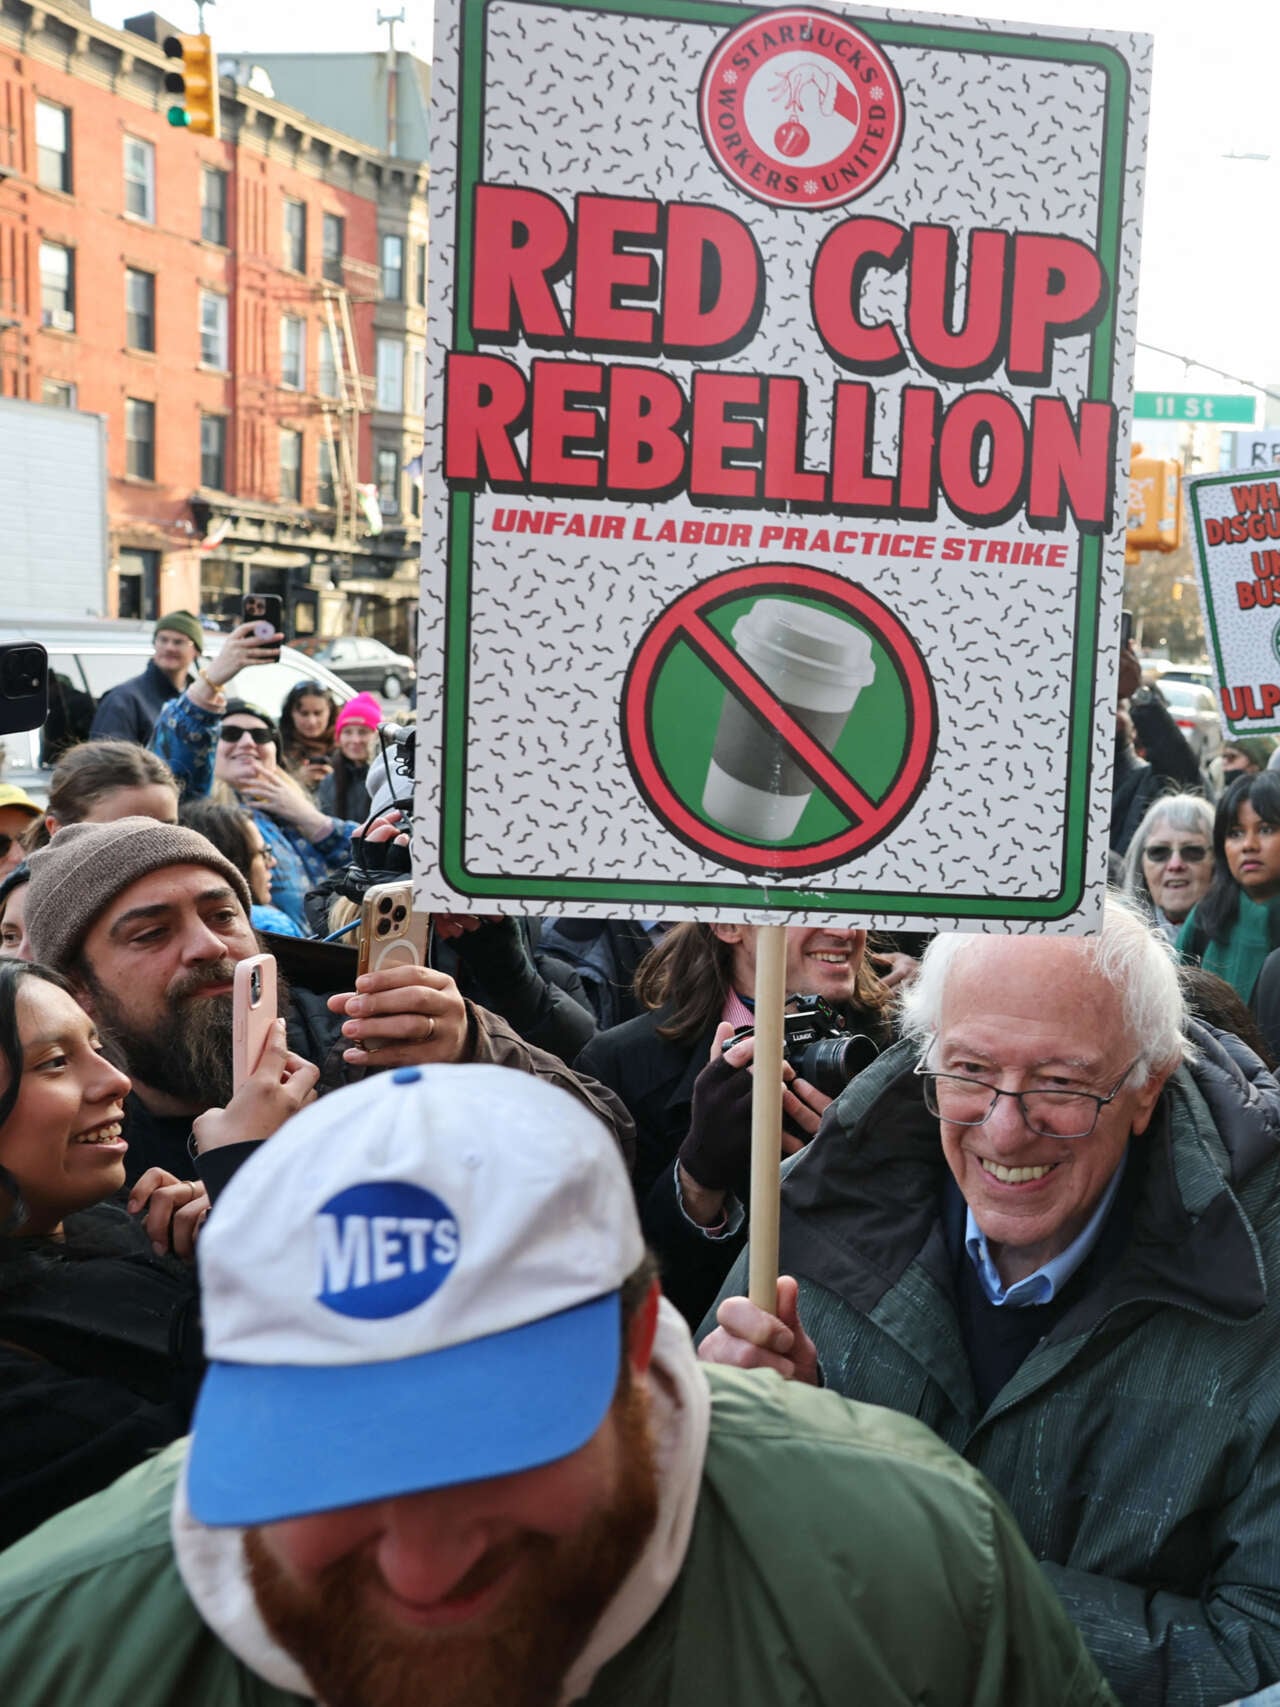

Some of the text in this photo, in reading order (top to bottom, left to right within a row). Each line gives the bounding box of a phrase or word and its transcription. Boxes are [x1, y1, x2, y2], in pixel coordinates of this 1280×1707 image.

[732, 23, 878, 84] STARBUCKS
[718, 88, 886, 193] WORKERS UNITED
[469, 183, 1111, 388] RED CUP
[444, 352, 1115, 532] REBELLION
[1156, 396, 1214, 418] 11 St
[492, 508, 1068, 568] UNFAIR LABOR PRACTICE STRIKE
[315, 1213, 459, 1296] METS
